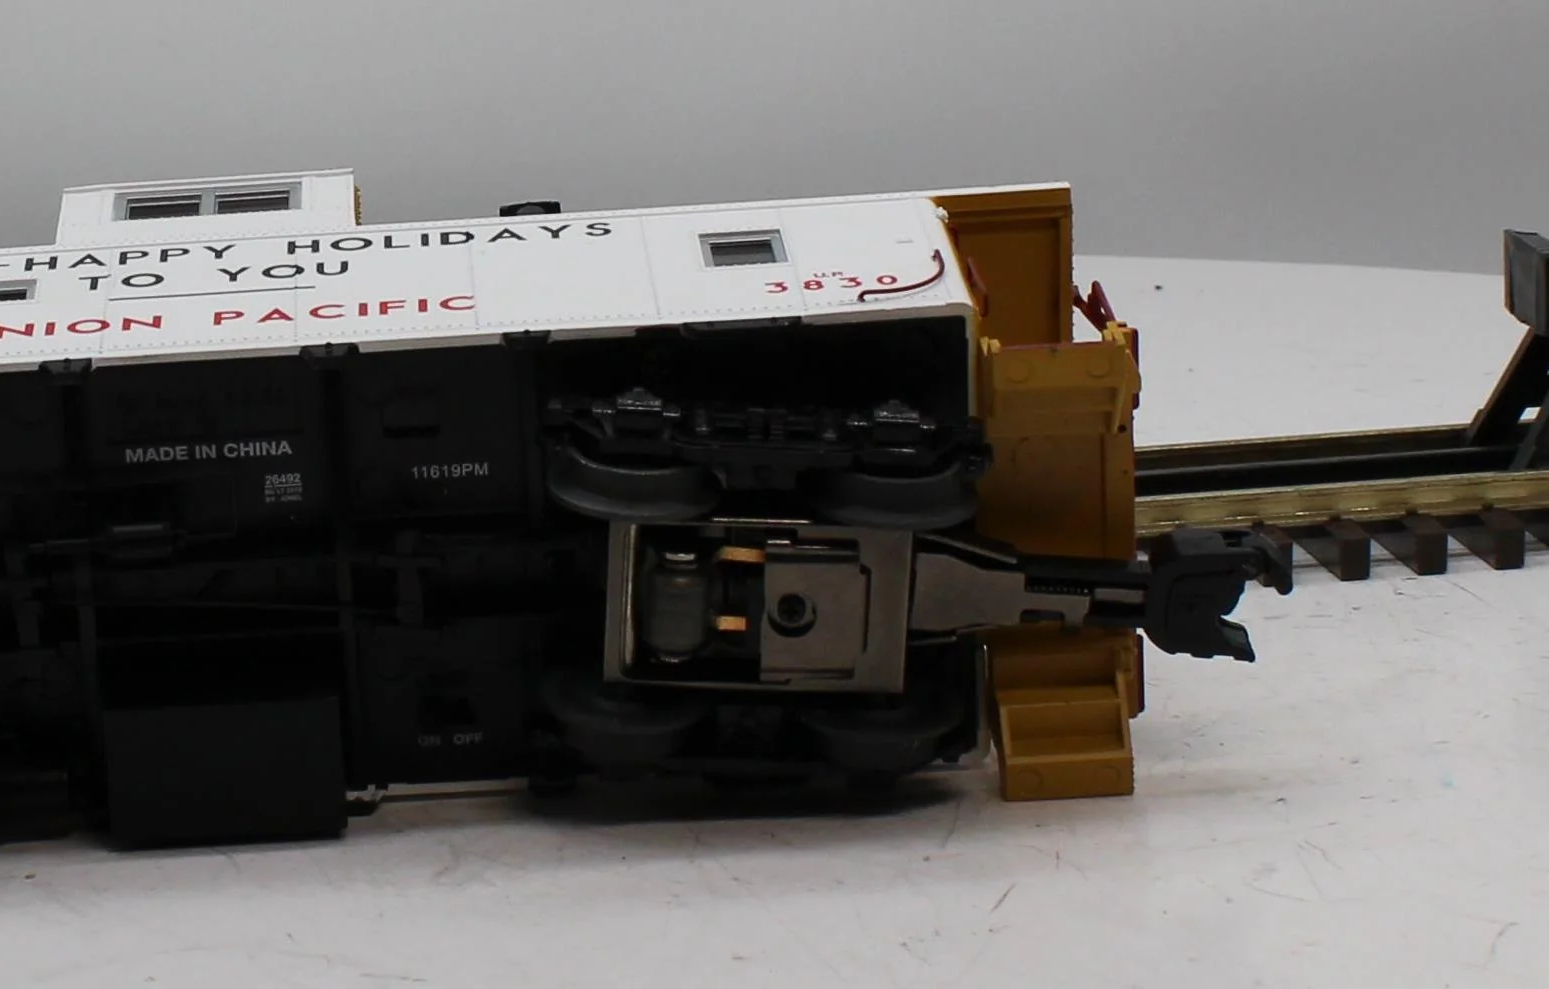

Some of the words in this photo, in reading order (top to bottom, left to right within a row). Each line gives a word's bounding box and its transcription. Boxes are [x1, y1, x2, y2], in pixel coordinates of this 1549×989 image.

[285, 221, 614, 257] HOLIDAYS
[77, 270, 165, 291] TO
[217, 258, 351, 284] YOU
[764, 274, 898, 294] 3830
[212, 295, 478, 327] PACIFIC
[124, 445, 190, 465] MADE
[194, 443, 217, 461] IN
[222, 439, 293, 459] CHINA
[410, 461, 490, 481] 11619PM
[452, 731, 484, 746] OFF
